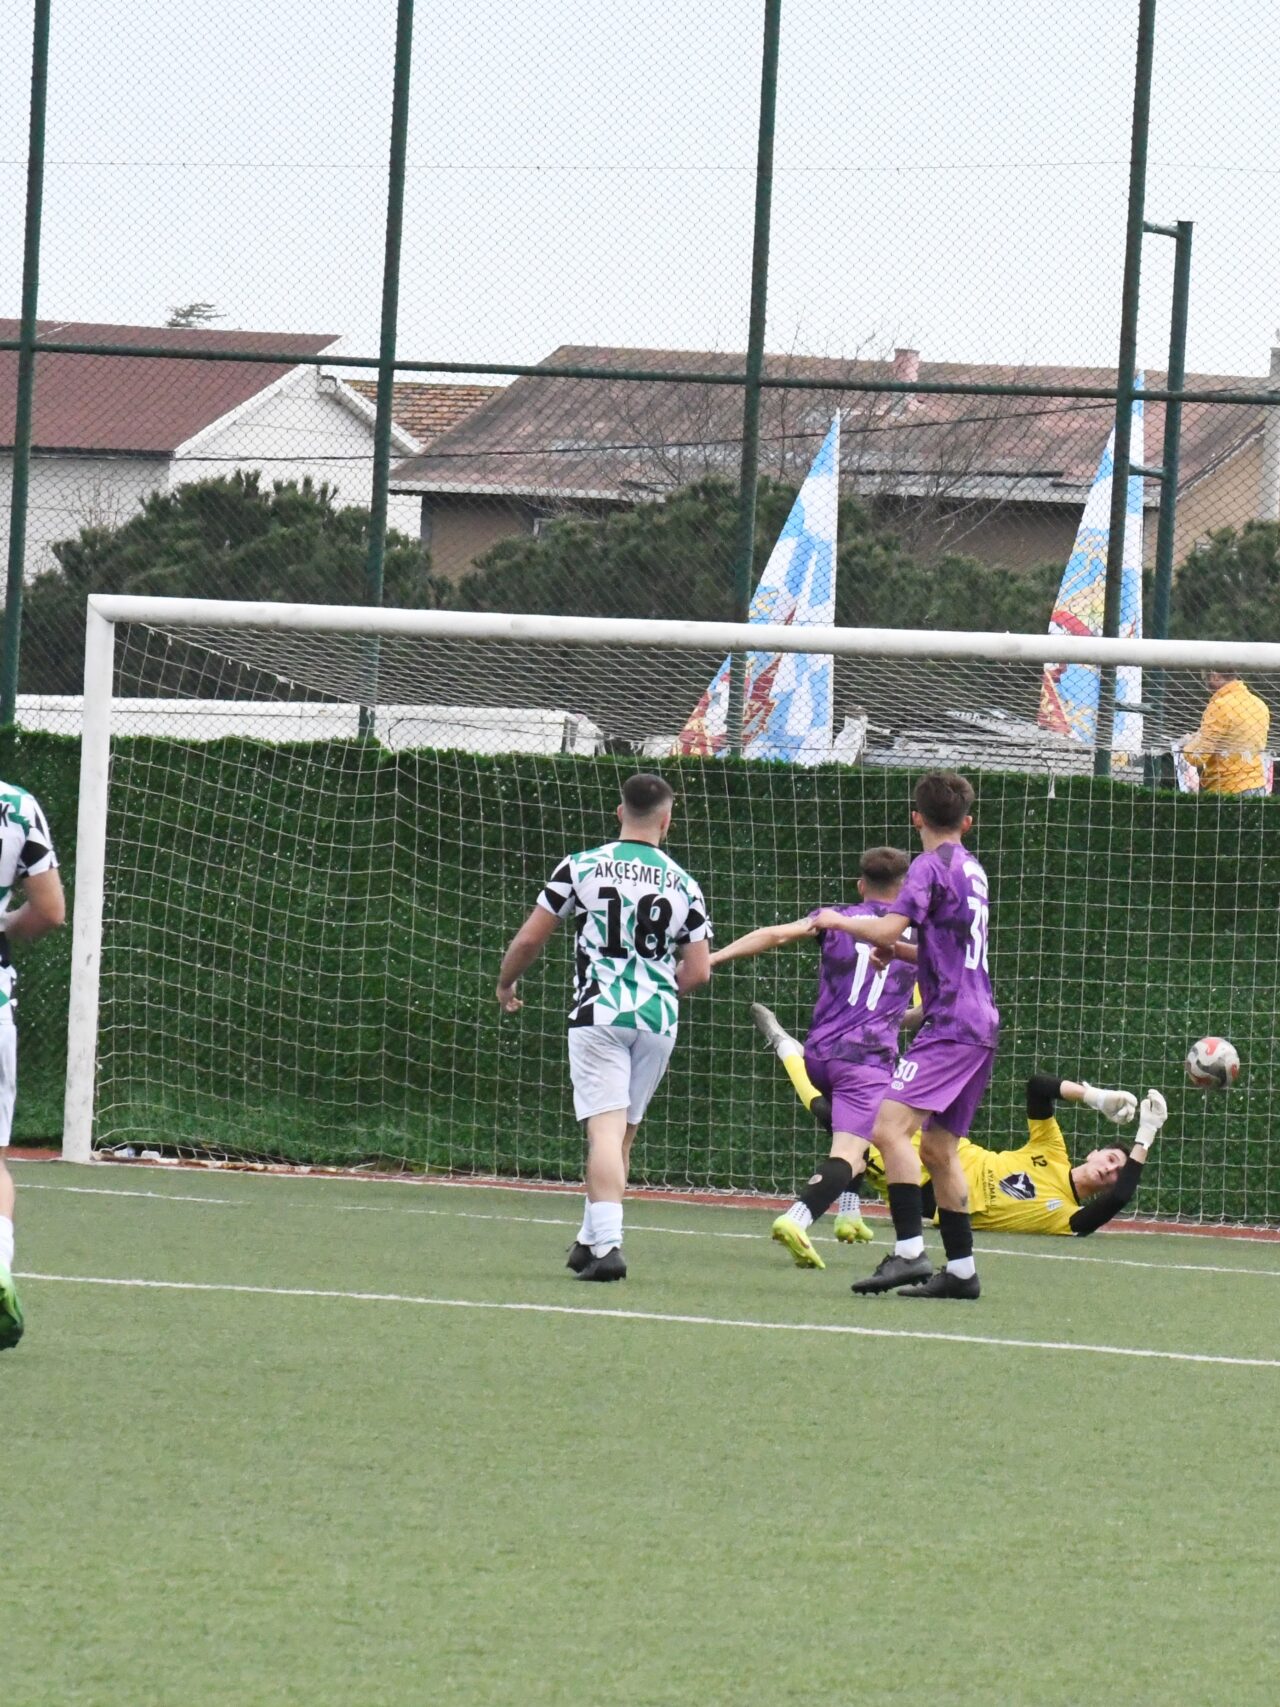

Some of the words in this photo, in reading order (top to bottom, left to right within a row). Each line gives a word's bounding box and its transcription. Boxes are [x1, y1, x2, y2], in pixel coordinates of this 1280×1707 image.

[595, 861, 661, 887] AKÇEŞME
[598, 886, 673, 961] 18
[893, 1057, 919, 1082] 30
[1031, 1154, 1047, 1168] 12
